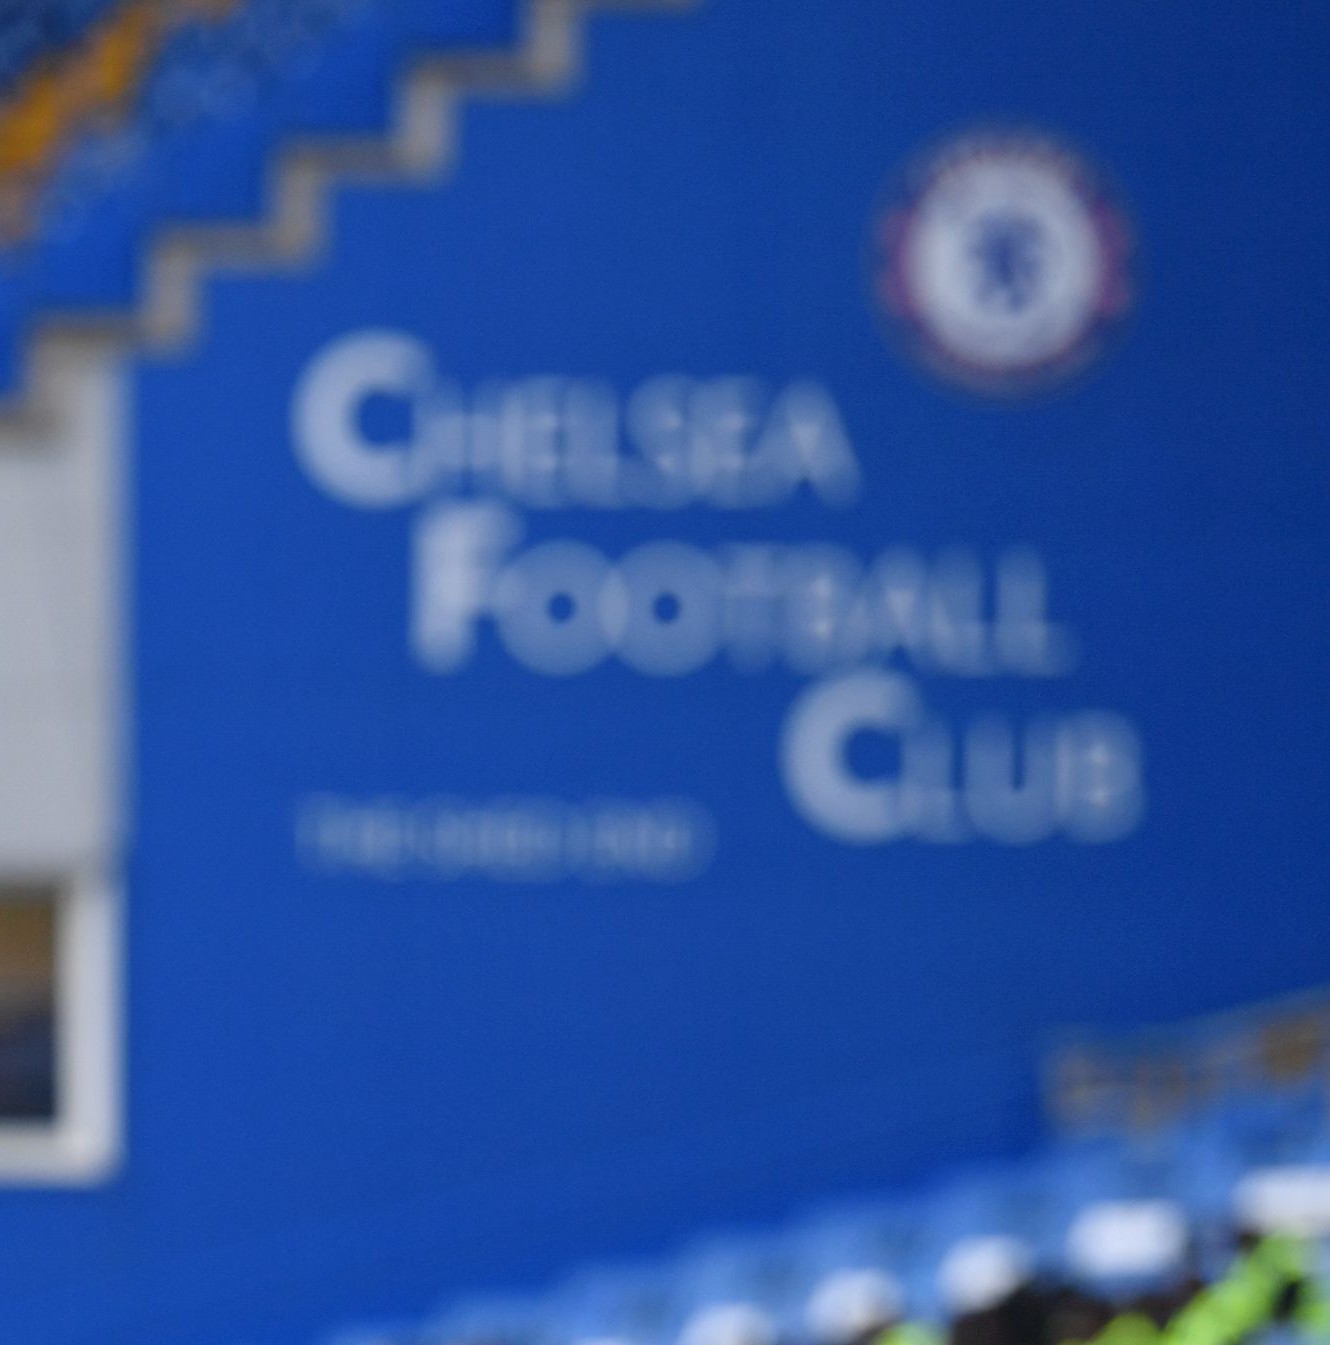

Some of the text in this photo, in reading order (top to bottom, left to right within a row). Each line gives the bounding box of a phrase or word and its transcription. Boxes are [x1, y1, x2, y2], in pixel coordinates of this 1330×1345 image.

[294, 331, 857, 507] CHELSEA
[412, 500, 1075, 675] FOOTBALL
[782, 667, 1141, 843] CLUB
